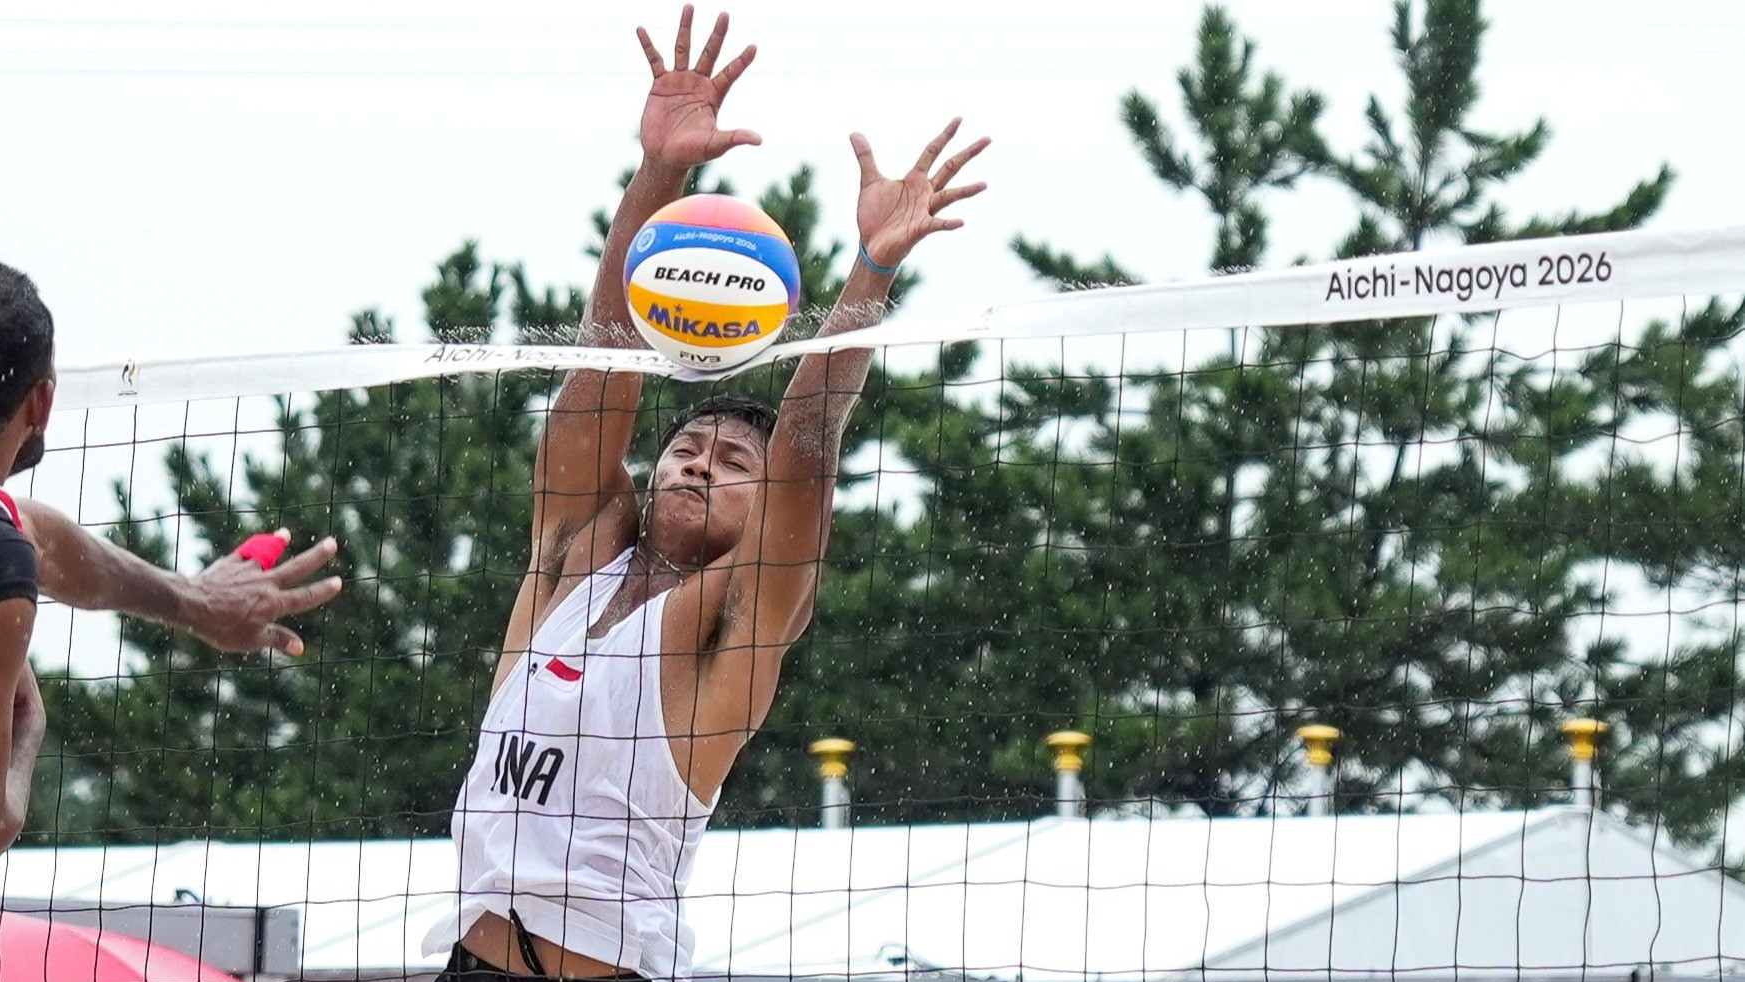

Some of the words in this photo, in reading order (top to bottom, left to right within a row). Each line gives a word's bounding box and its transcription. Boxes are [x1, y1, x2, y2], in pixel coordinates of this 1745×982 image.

[654, 266, 721, 286] BEACH
[724, 274, 766, 292] PRO
[1325, 263, 1527, 302] Aichi-Nagoya
[1538, 252, 1612, 286] 2026
[490, 731, 566, 807] INA
